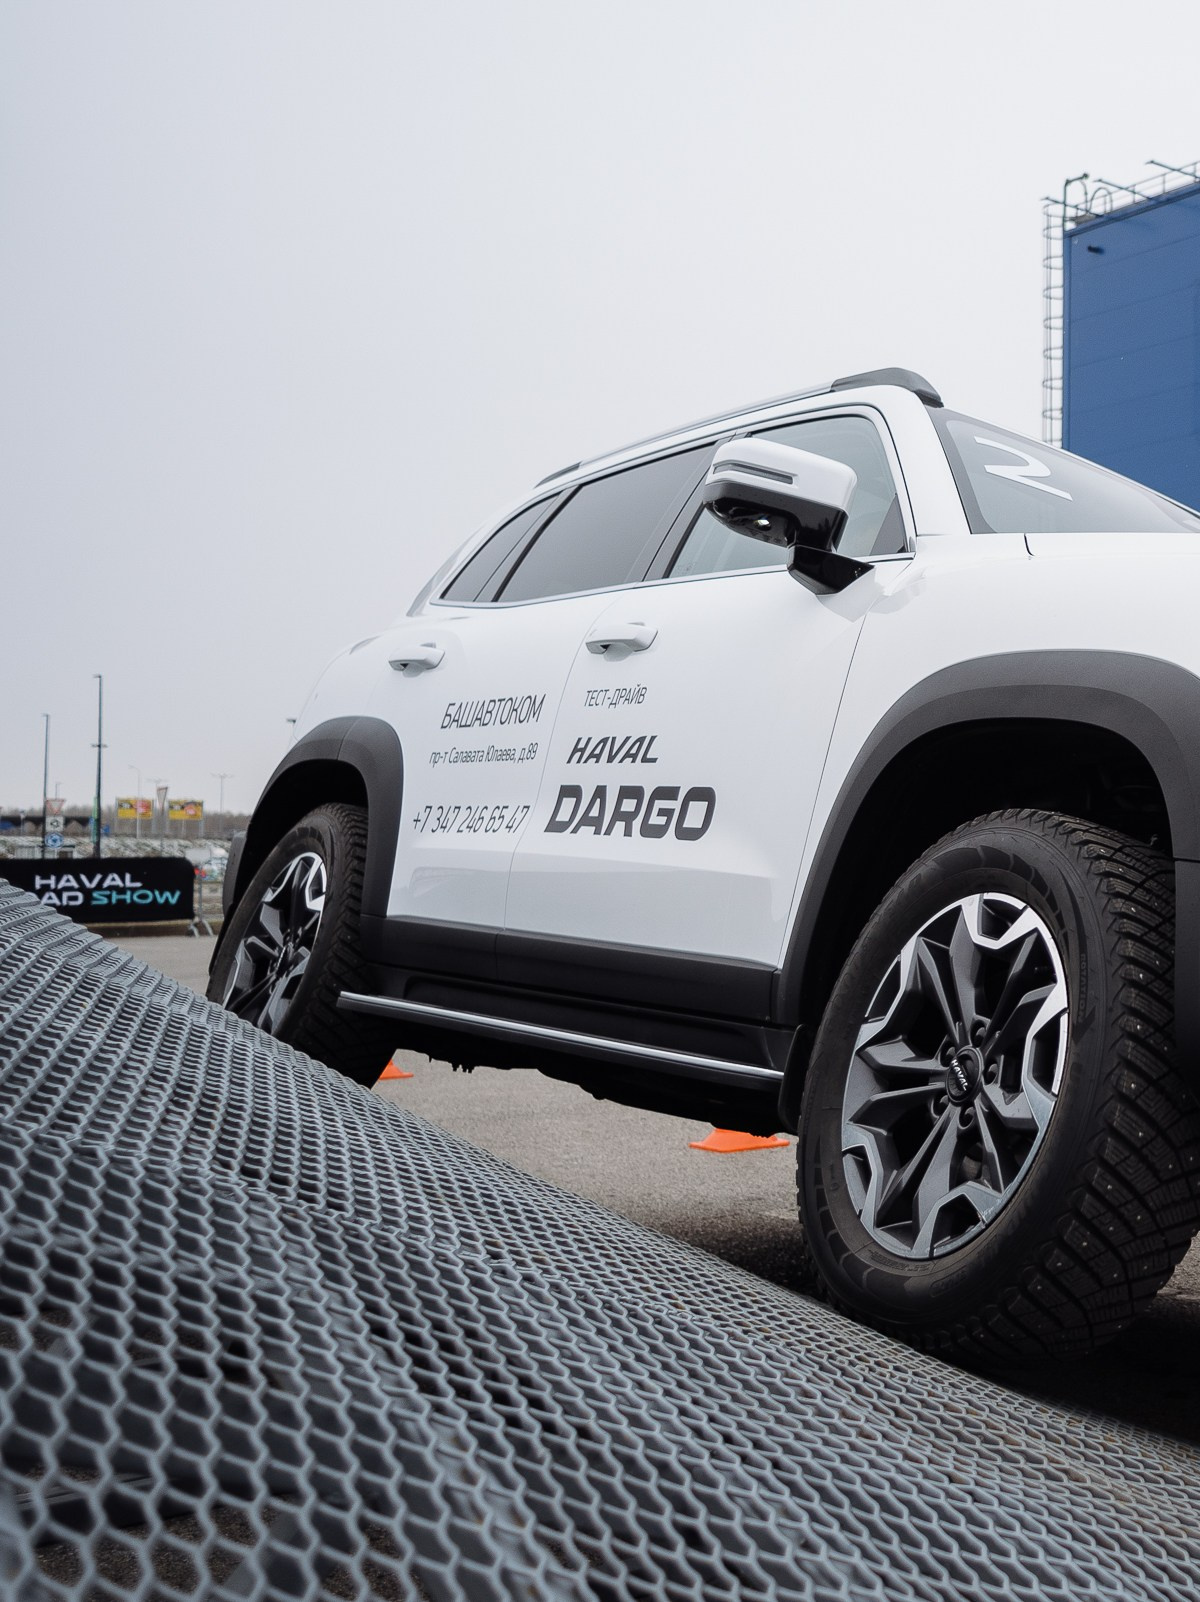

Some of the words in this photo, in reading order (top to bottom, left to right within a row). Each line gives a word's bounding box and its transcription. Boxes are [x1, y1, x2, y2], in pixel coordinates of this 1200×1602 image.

[583, 683, 648, 710] ТЕСТ-ДРАЙВ
[440, 693, 547, 730] БАШАВТОКОМ
[428, 750, 449, 768] пр-т
[448, 746, 485, 764] Салавата
[484, 744, 518, 765] Юлаева,
[566, 734, 659, 765] HAVAL
[412, 805, 434, 833] +7
[431, 805, 461, 833] 347
[456, 805, 489, 833] 246
[484, 805, 510, 833] 65
[505, 805, 531, 833] 47
[543, 784, 717, 842] DARGO
[34, 872, 143, 890] HAVAL
[91, 889, 181, 906] SHOW
[950, 1058, 969, 1092] HAVAL
